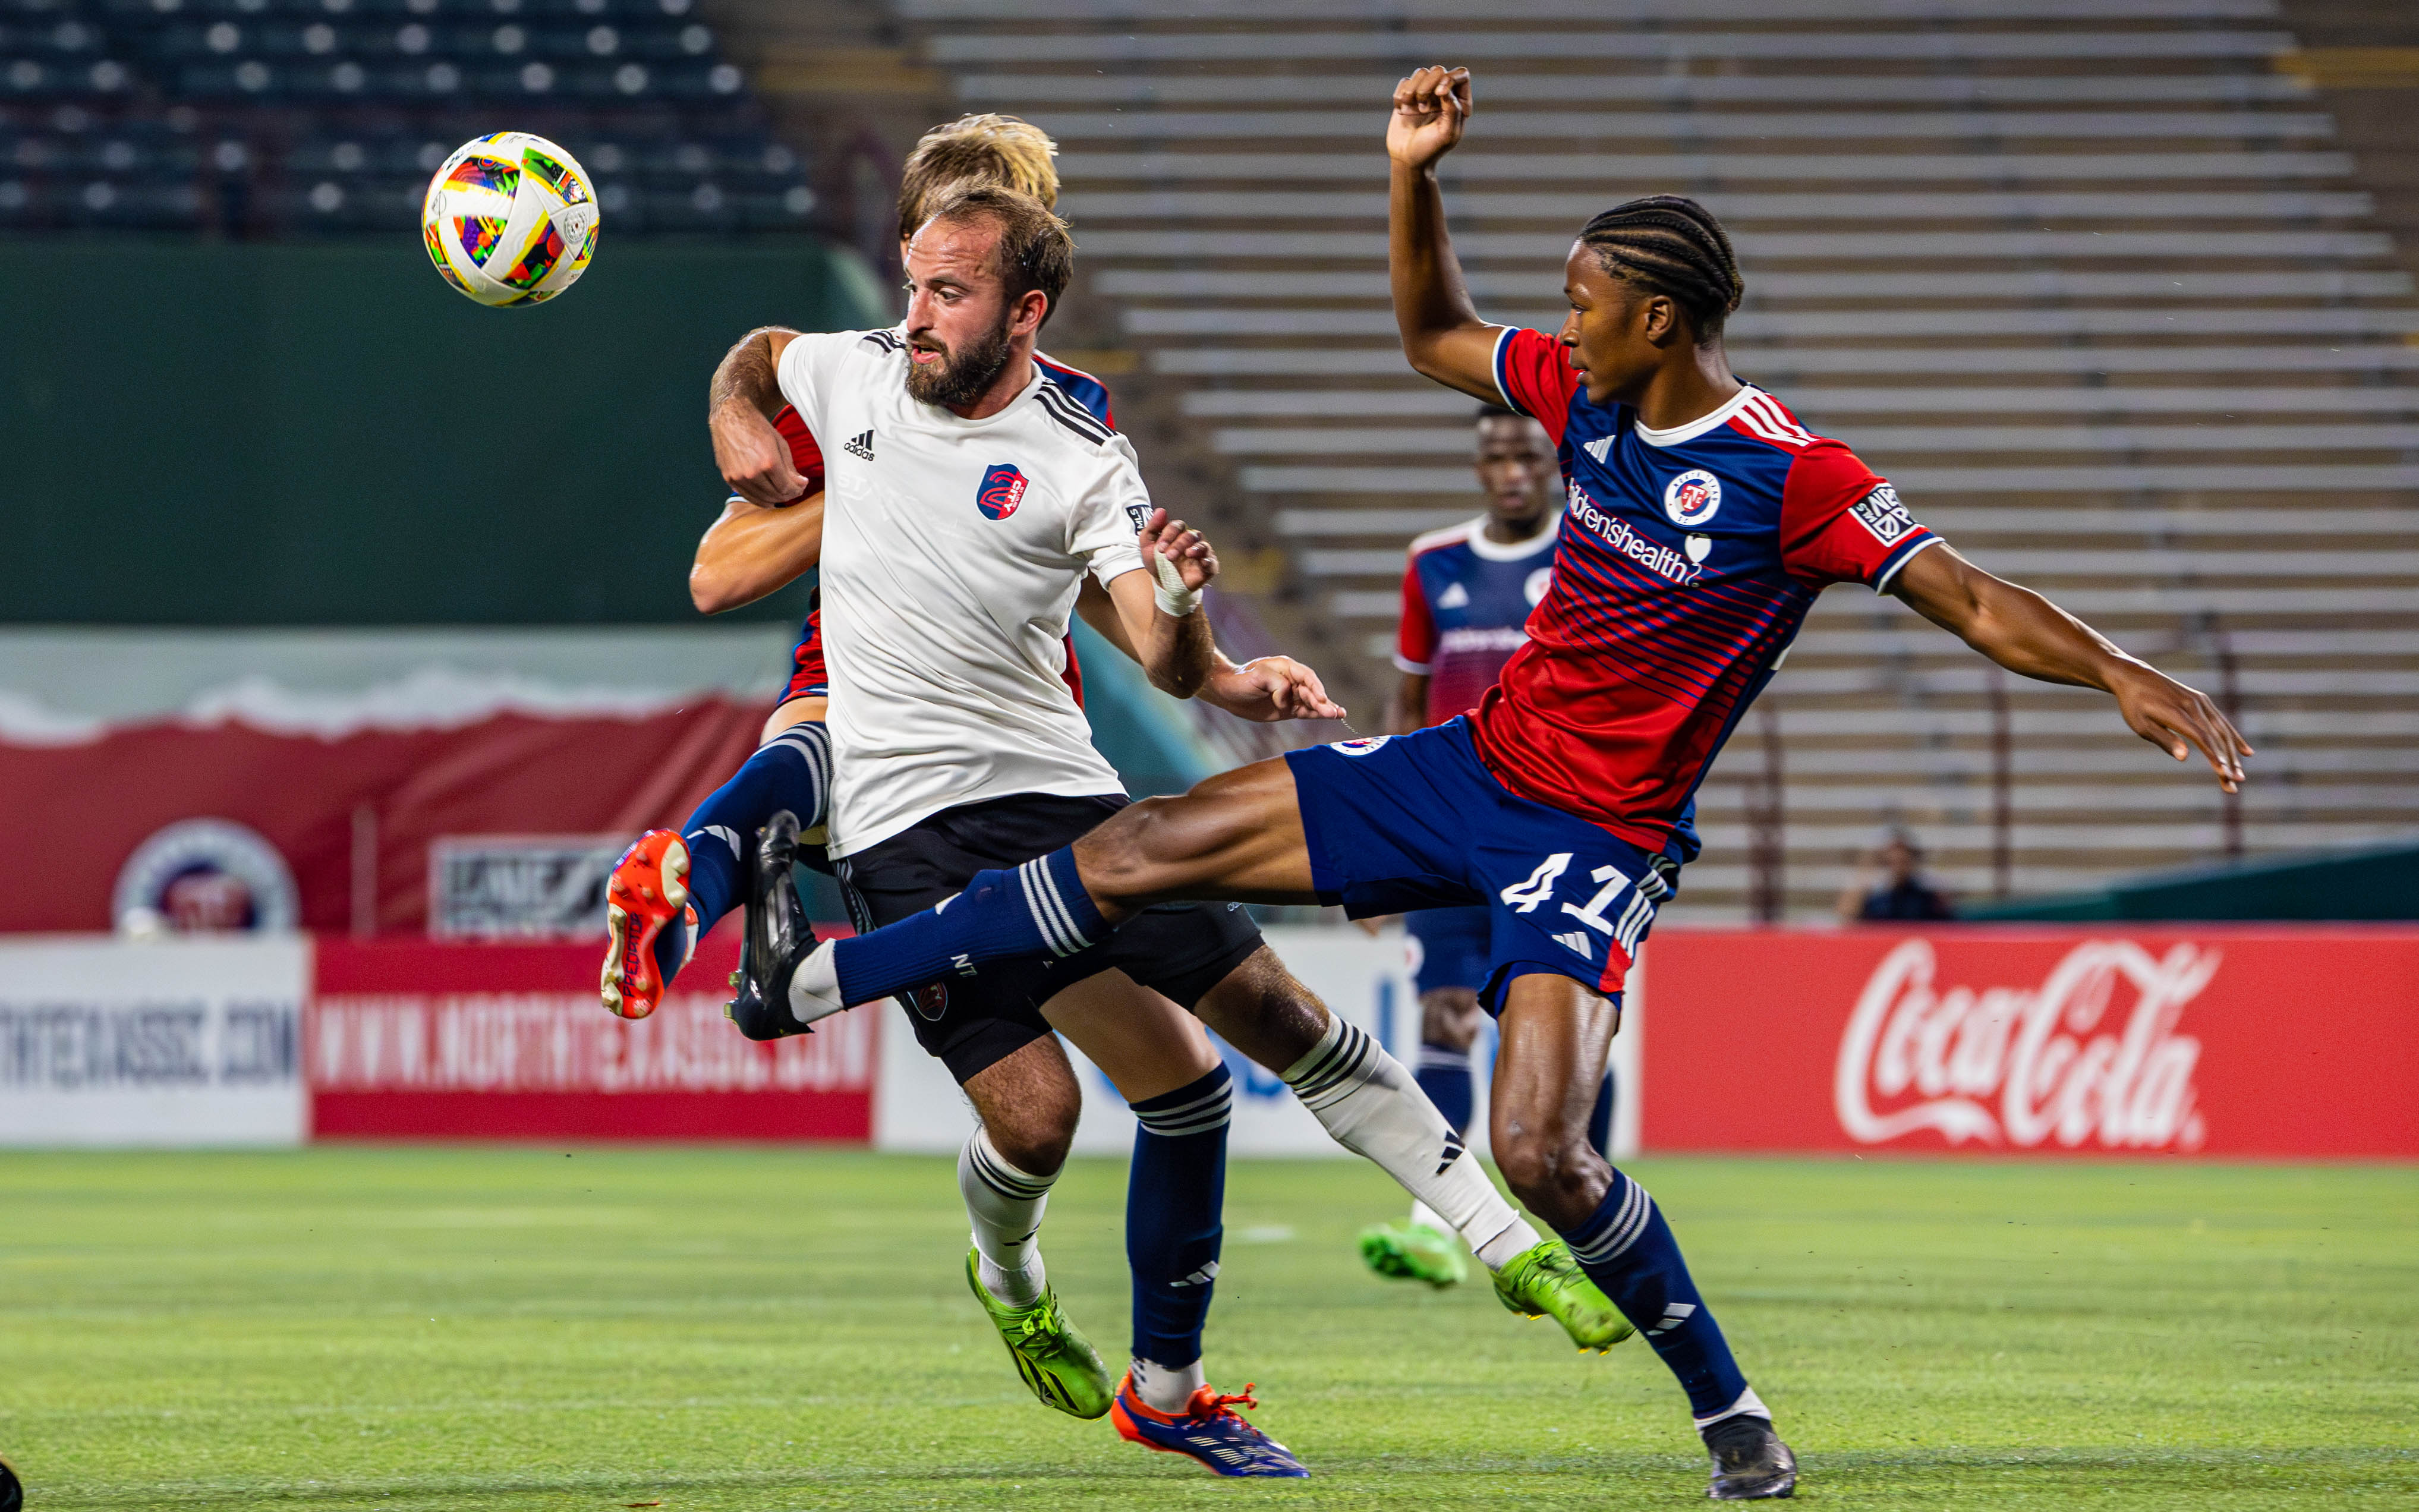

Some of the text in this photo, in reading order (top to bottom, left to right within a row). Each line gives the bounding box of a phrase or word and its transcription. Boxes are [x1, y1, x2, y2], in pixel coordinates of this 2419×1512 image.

[844, 442, 875, 461] adidas
[1004, 480, 1022, 512] CITY
[1129, 508, 1144, 529] MLS
[1500, 853, 1631, 936] 41
